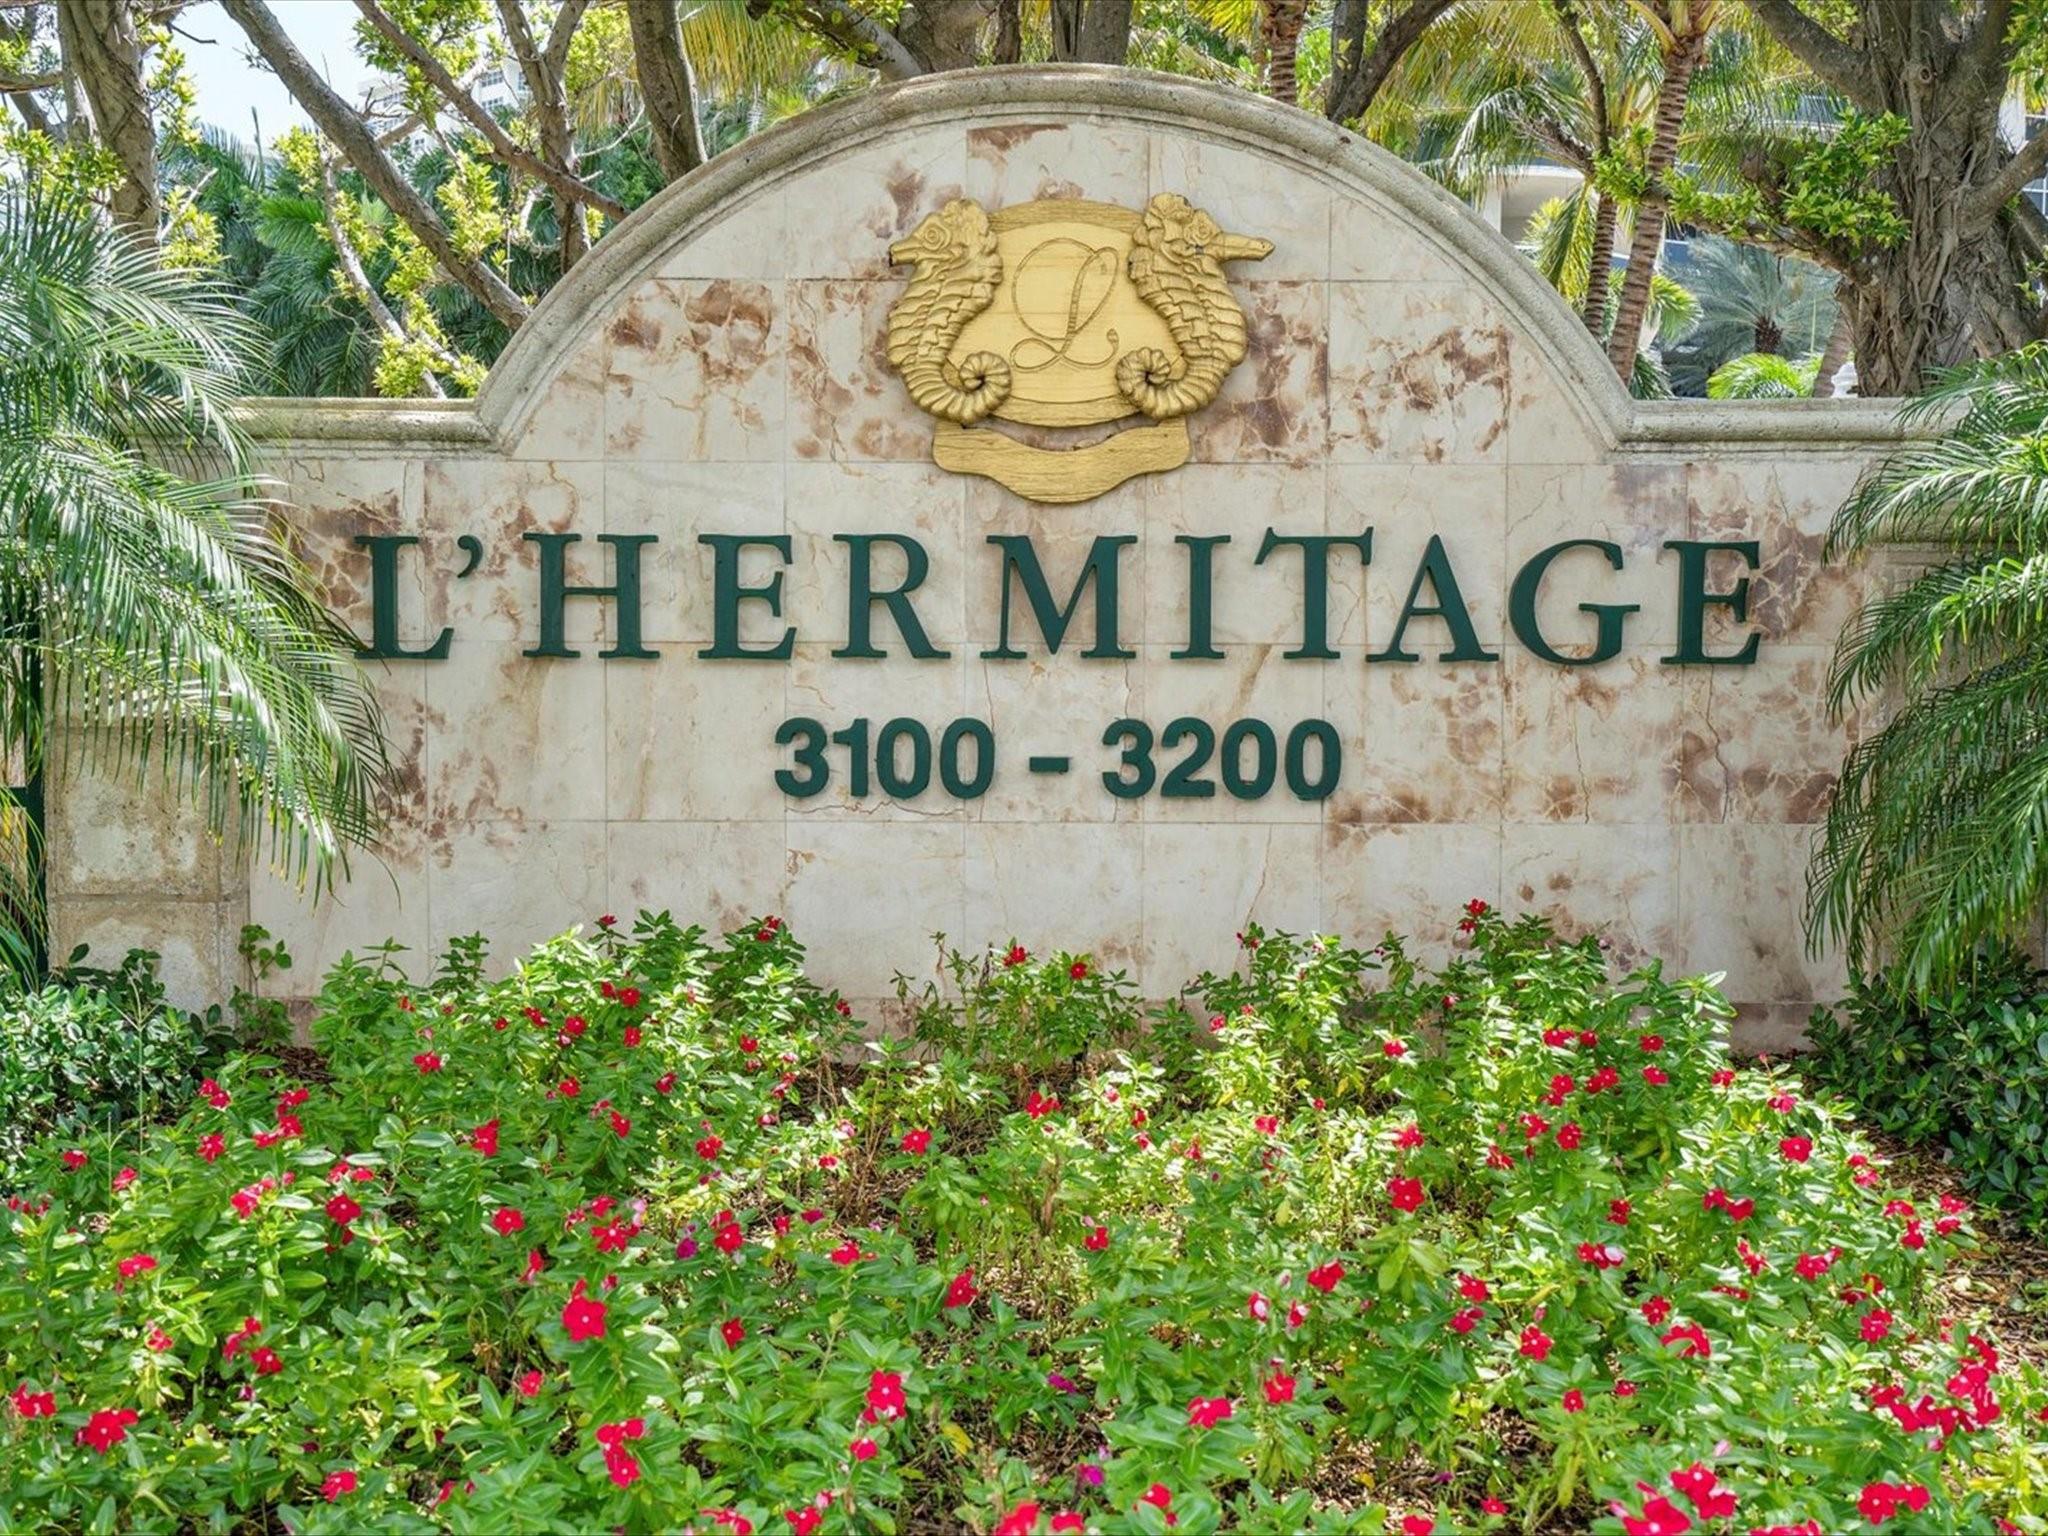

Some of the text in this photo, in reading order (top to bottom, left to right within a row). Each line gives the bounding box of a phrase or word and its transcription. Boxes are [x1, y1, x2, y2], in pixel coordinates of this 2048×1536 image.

[355, 526, 1763, 667] L'HERMITAGE
[774, 716, 1342, 802] 3100 - 3200
